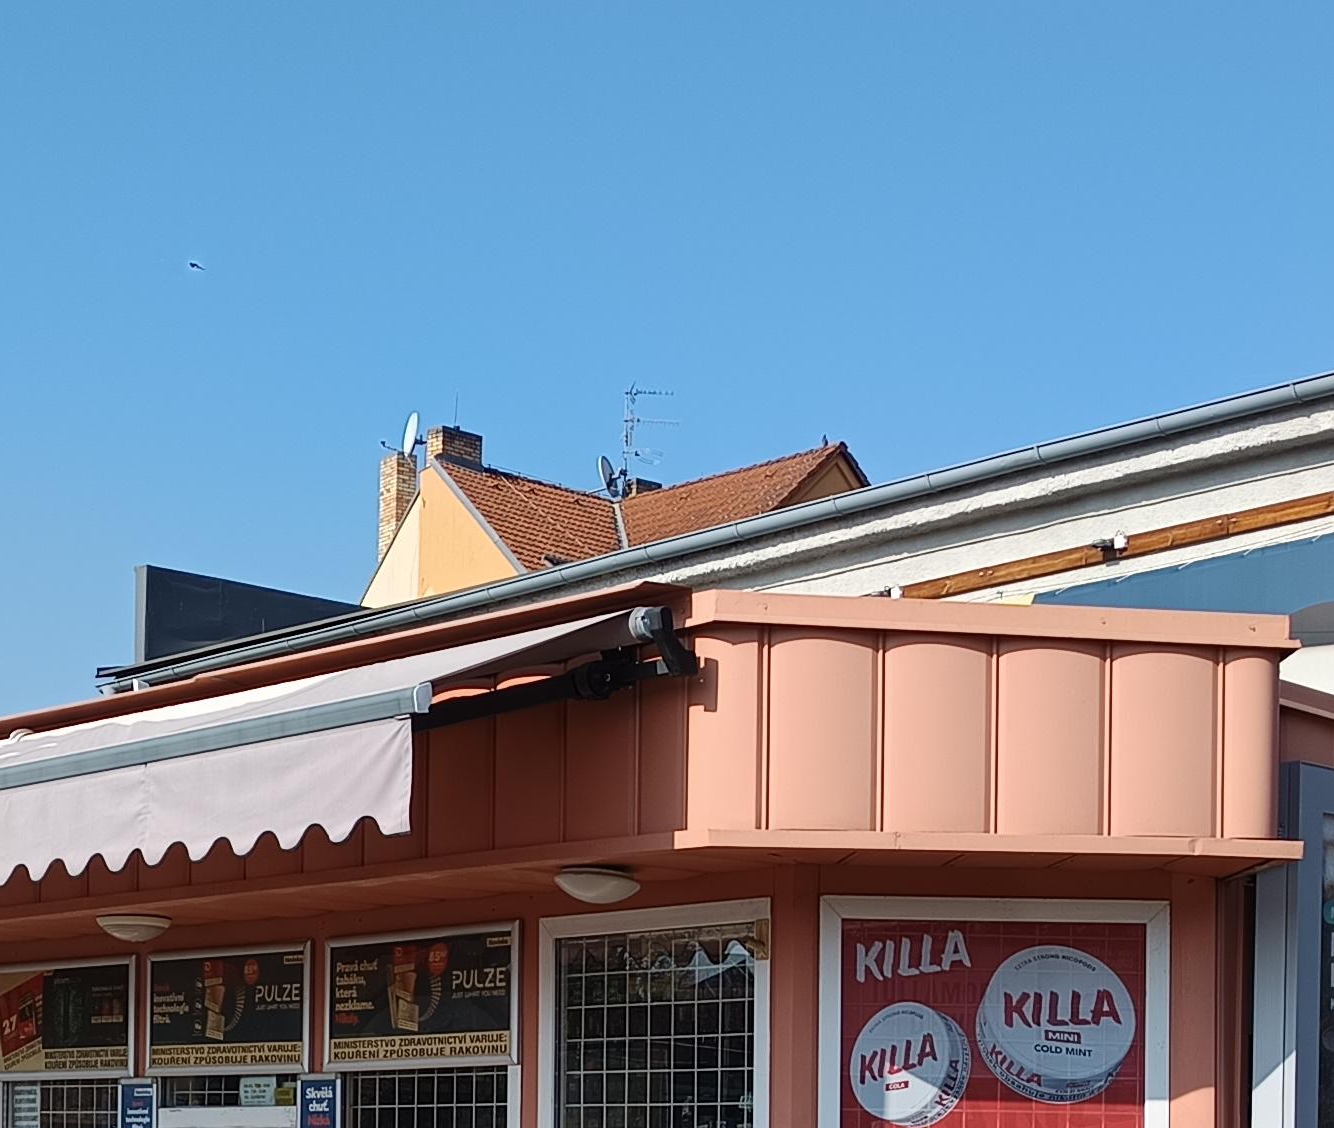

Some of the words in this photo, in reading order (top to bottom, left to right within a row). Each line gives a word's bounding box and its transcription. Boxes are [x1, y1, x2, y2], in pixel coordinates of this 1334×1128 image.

[856, 929, 972, 983] KILLA
[1033, 954, 1060, 962] STRONG
[452, 967, 507, 989] PULZE
[255, 984, 301, 1003] PULZE
[1003, 988, 1122, 1029] KILLA
[334, 1038, 396, 1049] MINISTERSTVO
[398, 1035, 467, 1047] ZDRAVOTNICTVÍ
[469, 1033, 508, 1043] VARUJE:
[1048, 1031, 1078, 1042] MINI
[152, 1046, 205, 1056] MINISTERSTVO
[207, 1044, 265, 1055] ZDRAVOTNICTVÍ
[267, 1044, 301, 1053] VARUJE:
[334, 1048, 380, 1060] KOUŘENÍ
[382, 1046, 446, 1058] ZPŮSOBUJE
[449, 1044, 507, 1056] RAKOVINU
[1034, 1044, 1063, 1054] COLD
[1065, 1045, 1093, 1057] MINT
[152, 1055, 191, 1066] KOUŘENÍ
[193, 1054, 248, 1065] ZPŮSOBUJE
[250, 1054, 301, 1063] RAKOVINU
[859, 1032, 938, 1085] KILLA
[989, 1043, 1043, 1088] KILLA
[888, 1081, 905, 1091] COLA
[934, 1059, 960, 1108] KILLA
[305, 1086, 333, 1099] Skvělá
